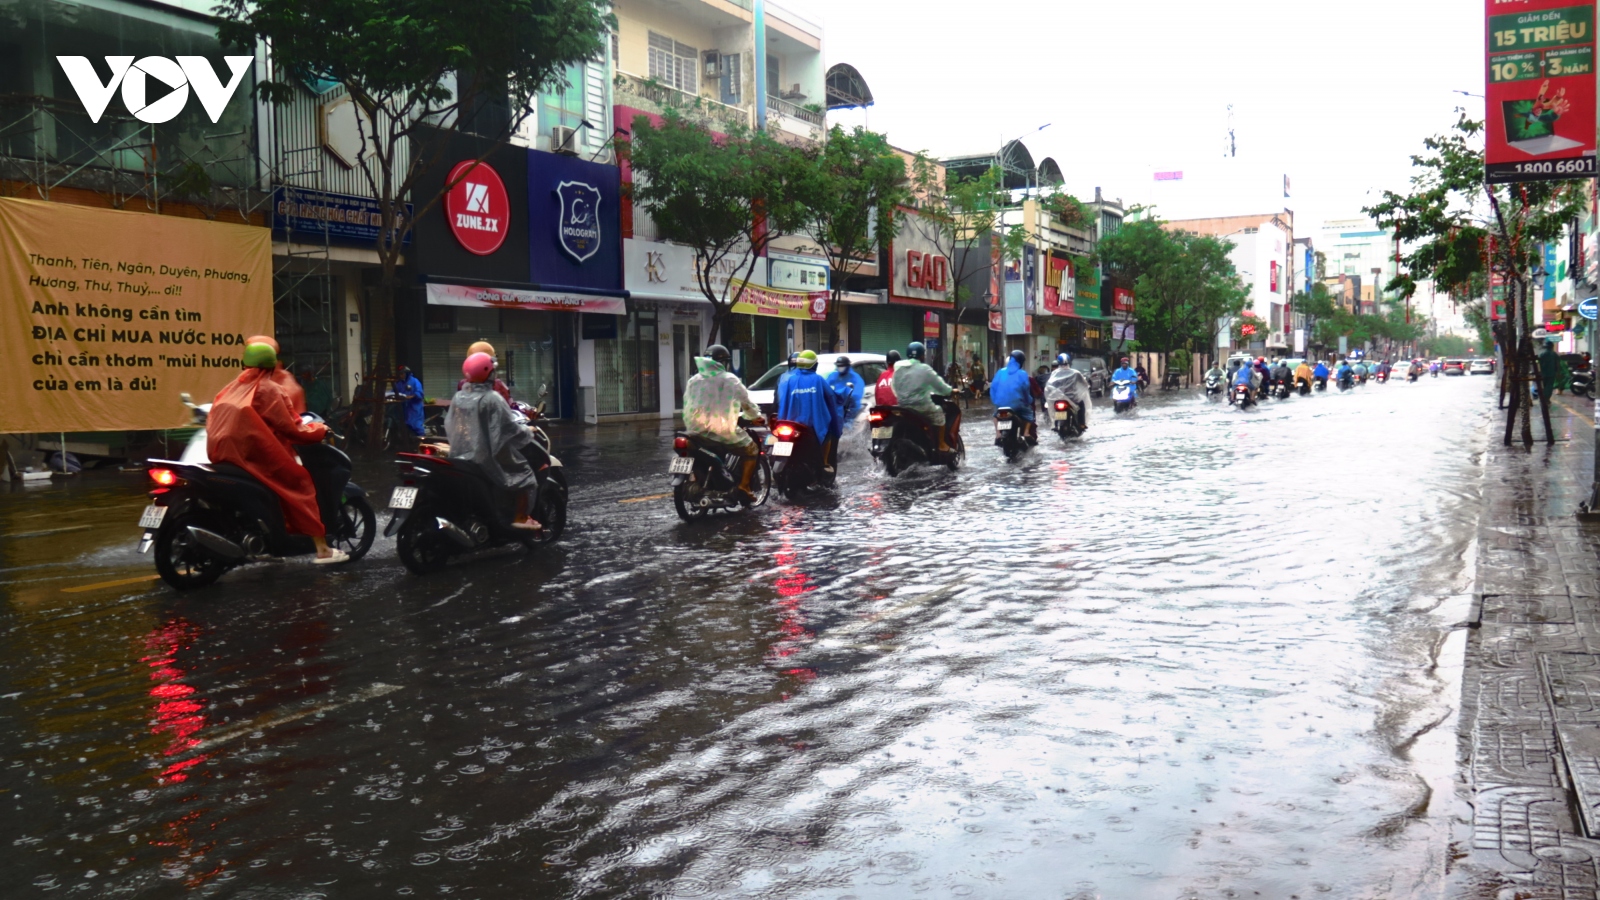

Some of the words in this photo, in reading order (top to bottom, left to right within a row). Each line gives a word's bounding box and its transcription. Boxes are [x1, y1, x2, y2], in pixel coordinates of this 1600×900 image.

[1542, 11, 1561, 21] ĐẾN
[1494, 30, 1516, 47] 15
[1519, 20, 1586, 44] TRIỆU
[1491, 62, 1518, 81] 10
[1521, 61, 1534, 72] %
[1548, 58, 1562, 75] 3
[1563, 63, 1589, 74] NĂM
[1515, 162, 1552, 173] 1800
[1555, 159, 1593, 173] 6601
[456, 213, 499, 233] ZUNE.ZX
[563, 226, 598, 240] HOLOGRAM
[29, 253, 77, 270] Thanh,
[82, 258, 113, 273] Tiên,
[117, 261, 155, 276] Ngân,
[160, 265, 201, 279] Duyên,
[204, 268, 251, 284] Phương,
[29, 275, 79, 292] Hương,
[84, 279, 112, 293] Thư,
[31, 300, 69, 316] Anh
[76, 303, 133, 322] không
[139, 305, 170, 320] cần
[175, 307, 201, 322] tìm
[31, 325, 67, 344] ĐỊA
[73, 323, 106, 342] CHỈ
[111, 329, 153, 343] MUA
[159, 328, 206, 344] NƯỚC
[211, 333, 246, 346] HOA
[68, 350, 100, 366] cần
[105, 353, 153, 367] thơm
[159, 354, 197, 367] "mùi
[32, 374, 68, 391] của
[74, 380, 102, 391] em
[107, 377, 123, 391] là
[129, 375, 157, 391] đủ!
